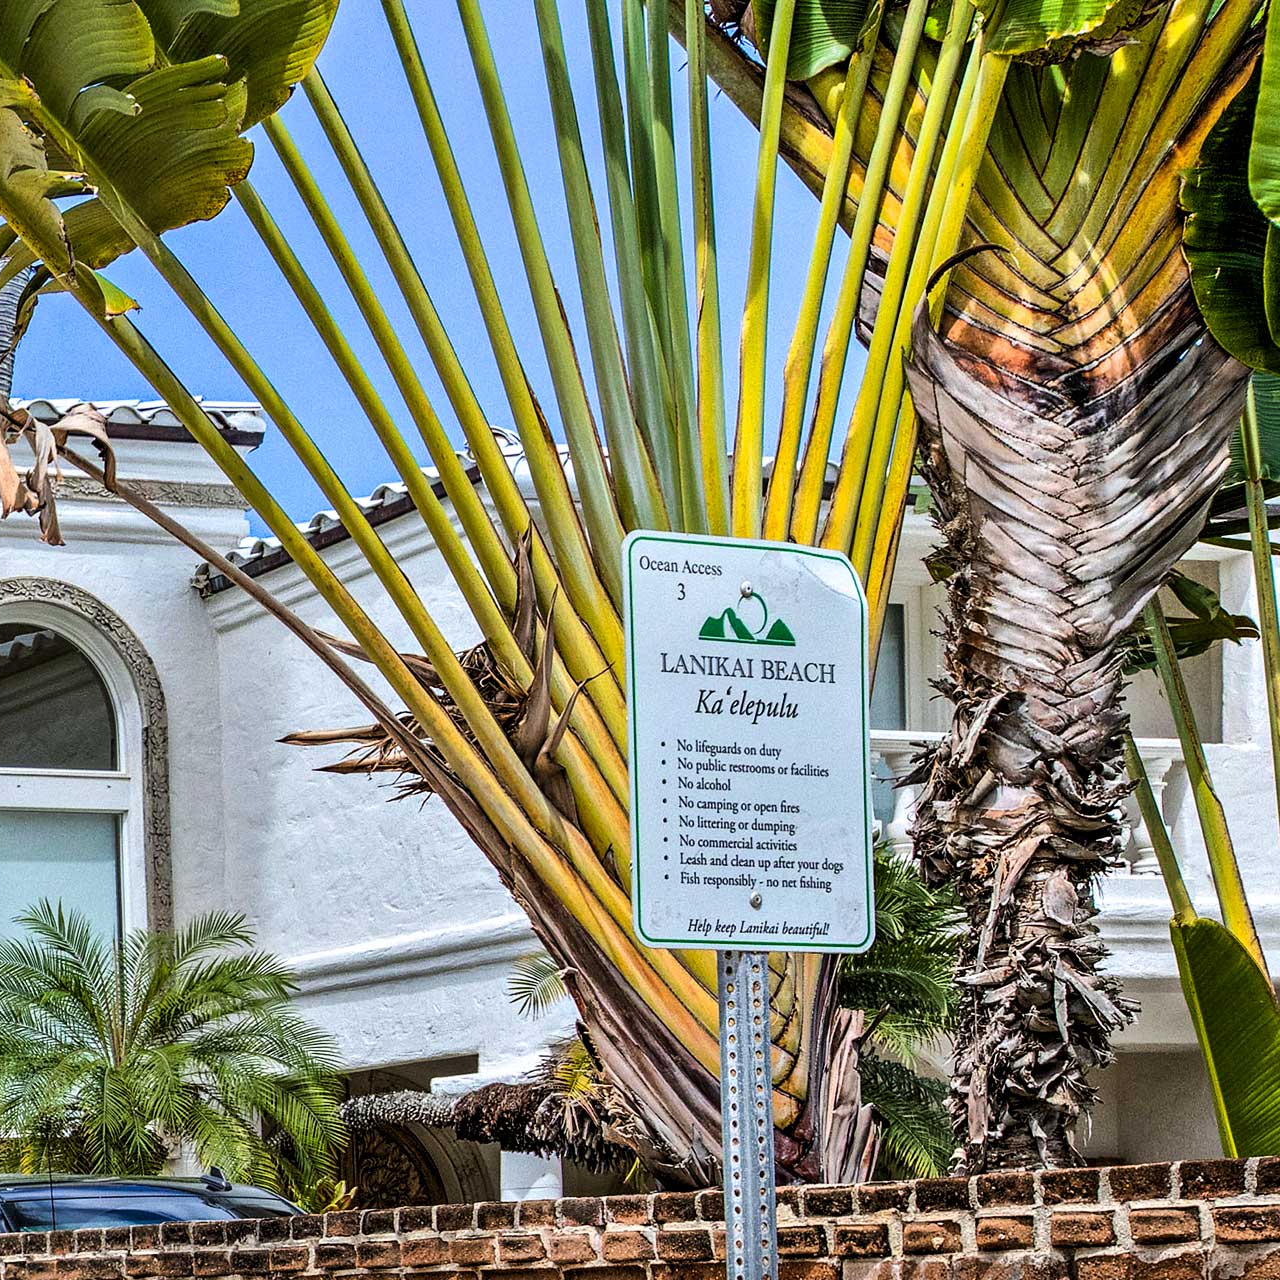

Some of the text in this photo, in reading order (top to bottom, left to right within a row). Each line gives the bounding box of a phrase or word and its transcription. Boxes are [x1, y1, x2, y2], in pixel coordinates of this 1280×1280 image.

[639, 556, 722, 576] Ocean Access
[677, 583, 686, 600] 3
[660, 653, 835, 684] LANIKAI BEACH
[677, 738, 781, 759] No lifeguards on duty
[678, 757, 829, 777] No public restrooms or facilities
[678, 776, 731, 791] No alcohol
[679, 795, 800, 815] No camping or open fires
[679, 815, 795, 835] No littering or dumping
[680, 834, 797, 851] No commercial activities
[680, 853, 844, 873] Leash and clean up after your dogs
[680, 872, 701, 884] Fish
[704, 873, 756, 889] responsibly
[766, 878, 779, 887] no
[782, 878, 797, 888] net
[799, 877, 832, 893] fishing
[687, 919, 829, 940] Help keep Lanikai beautiful!
